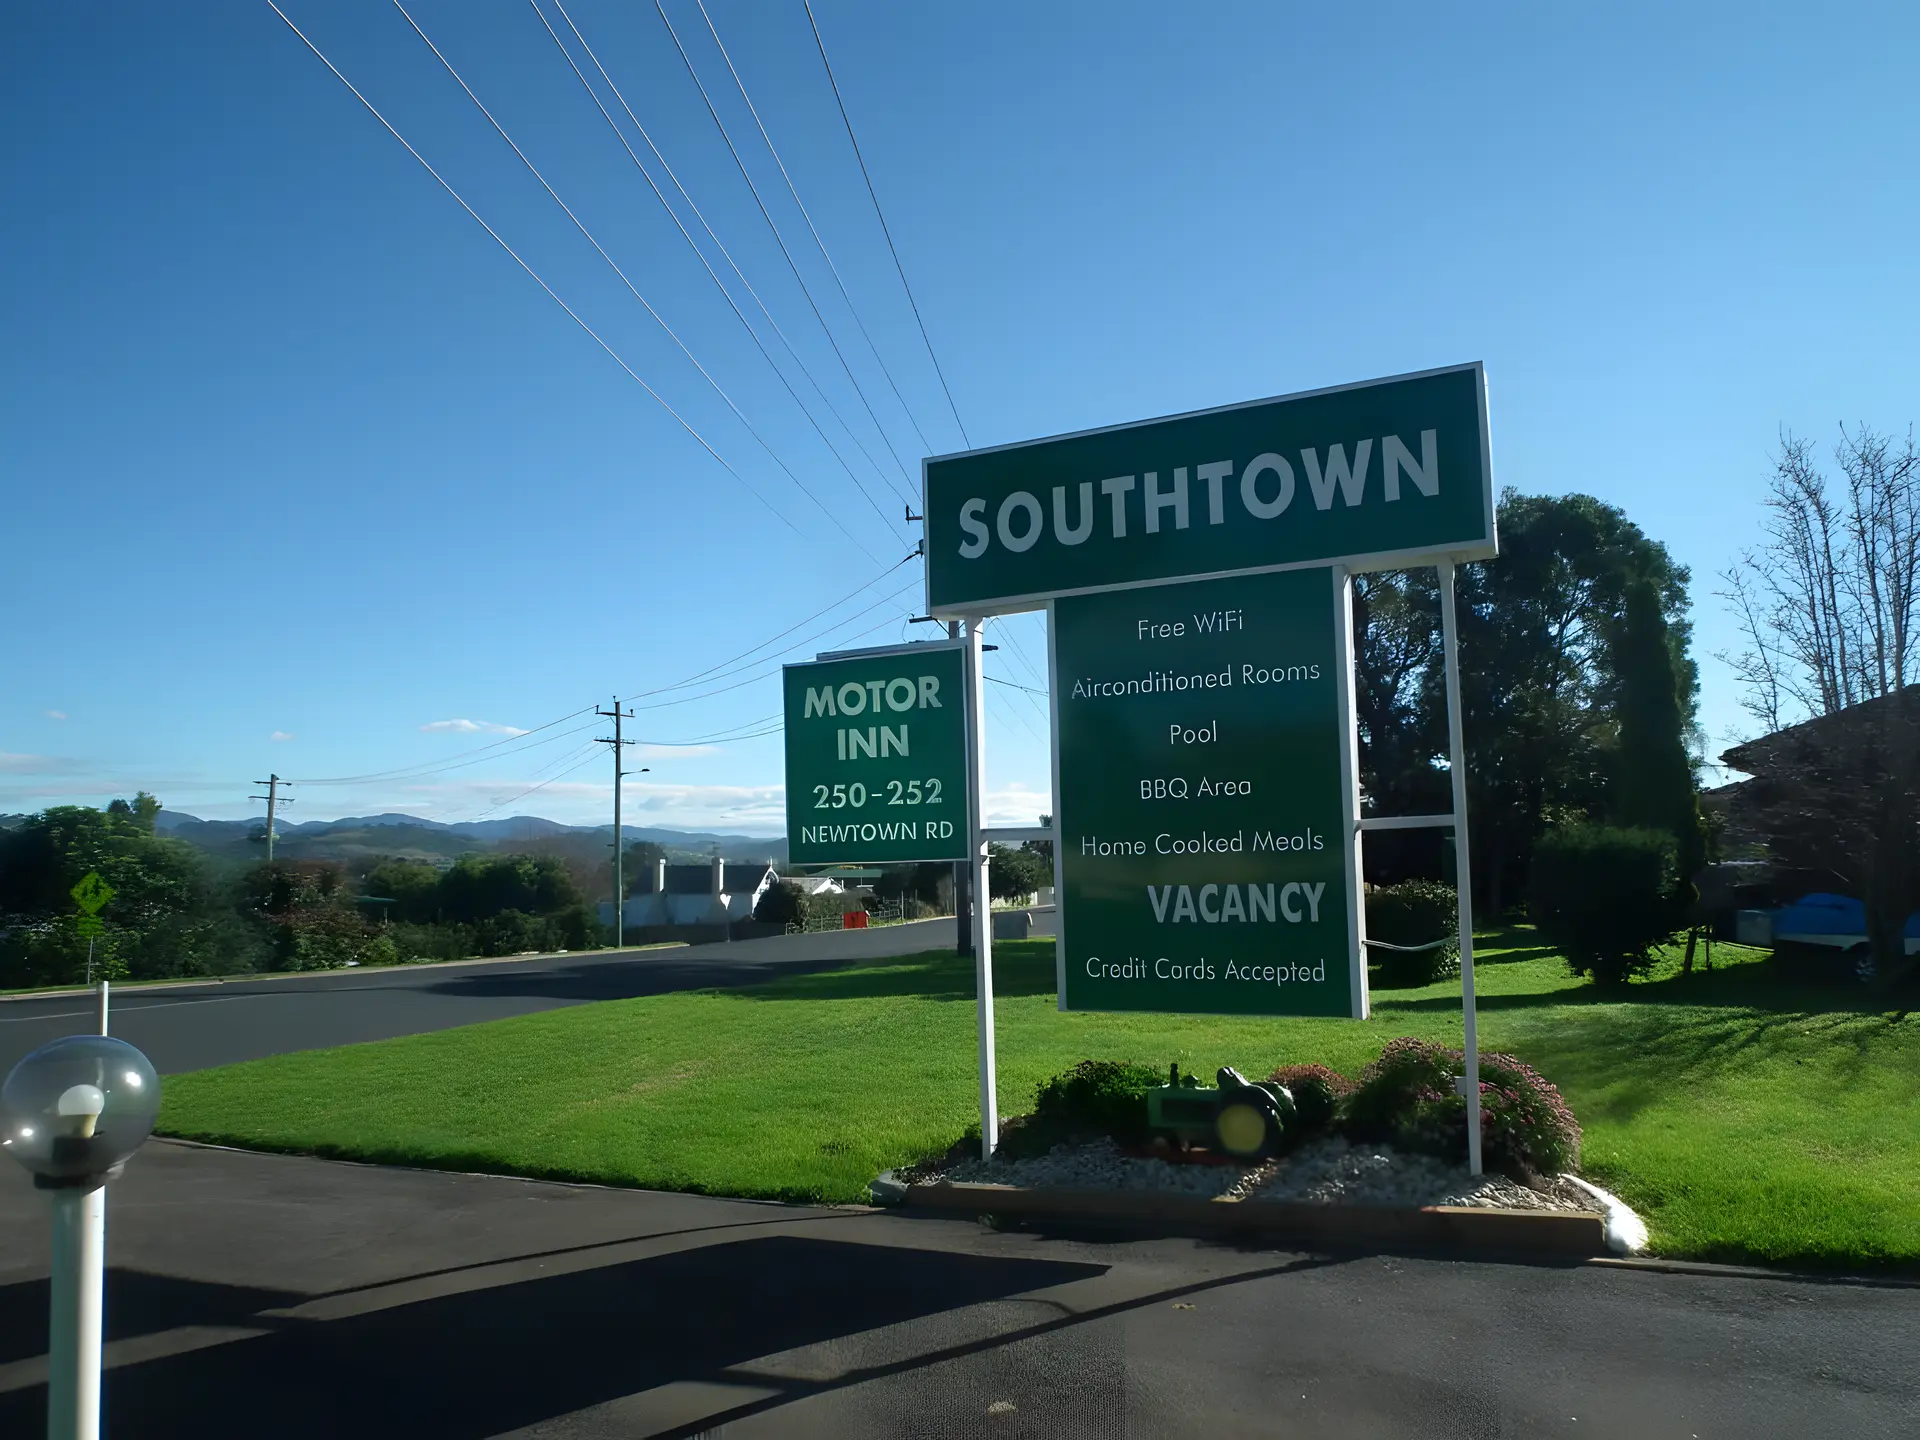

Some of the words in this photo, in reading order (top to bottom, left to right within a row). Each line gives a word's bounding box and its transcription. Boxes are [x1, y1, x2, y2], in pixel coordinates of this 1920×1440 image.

[957, 428, 1440, 560] SOUTHTOWN
[1139, 620, 1184, 640] Free
[1194, 610, 1242, 633] WiFi
[1071, 664, 1231, 699] Airconditioned
[1243, 665, 1319, 684] Rooms
[804, 676, 942, 718] MOTOR
[838, 725, 909, 760] INN
[1171, 720, 1216, 744] Pool
[1141, 778, 1188, 799] BBQ
[1198, 777, 1250, 797] Area
[803, 822, 916, 843] NEWTOWN
[927, 821, 953, 839] RD
[1083, 836, 1146, 855] Home
[1156, 830, 1242, 854] Cooked
[1147, 882, 1326, 924] VACANCY
[1087, 957, 1147, 978] Credit
[1225, 959, 1324, 986] Accepted
